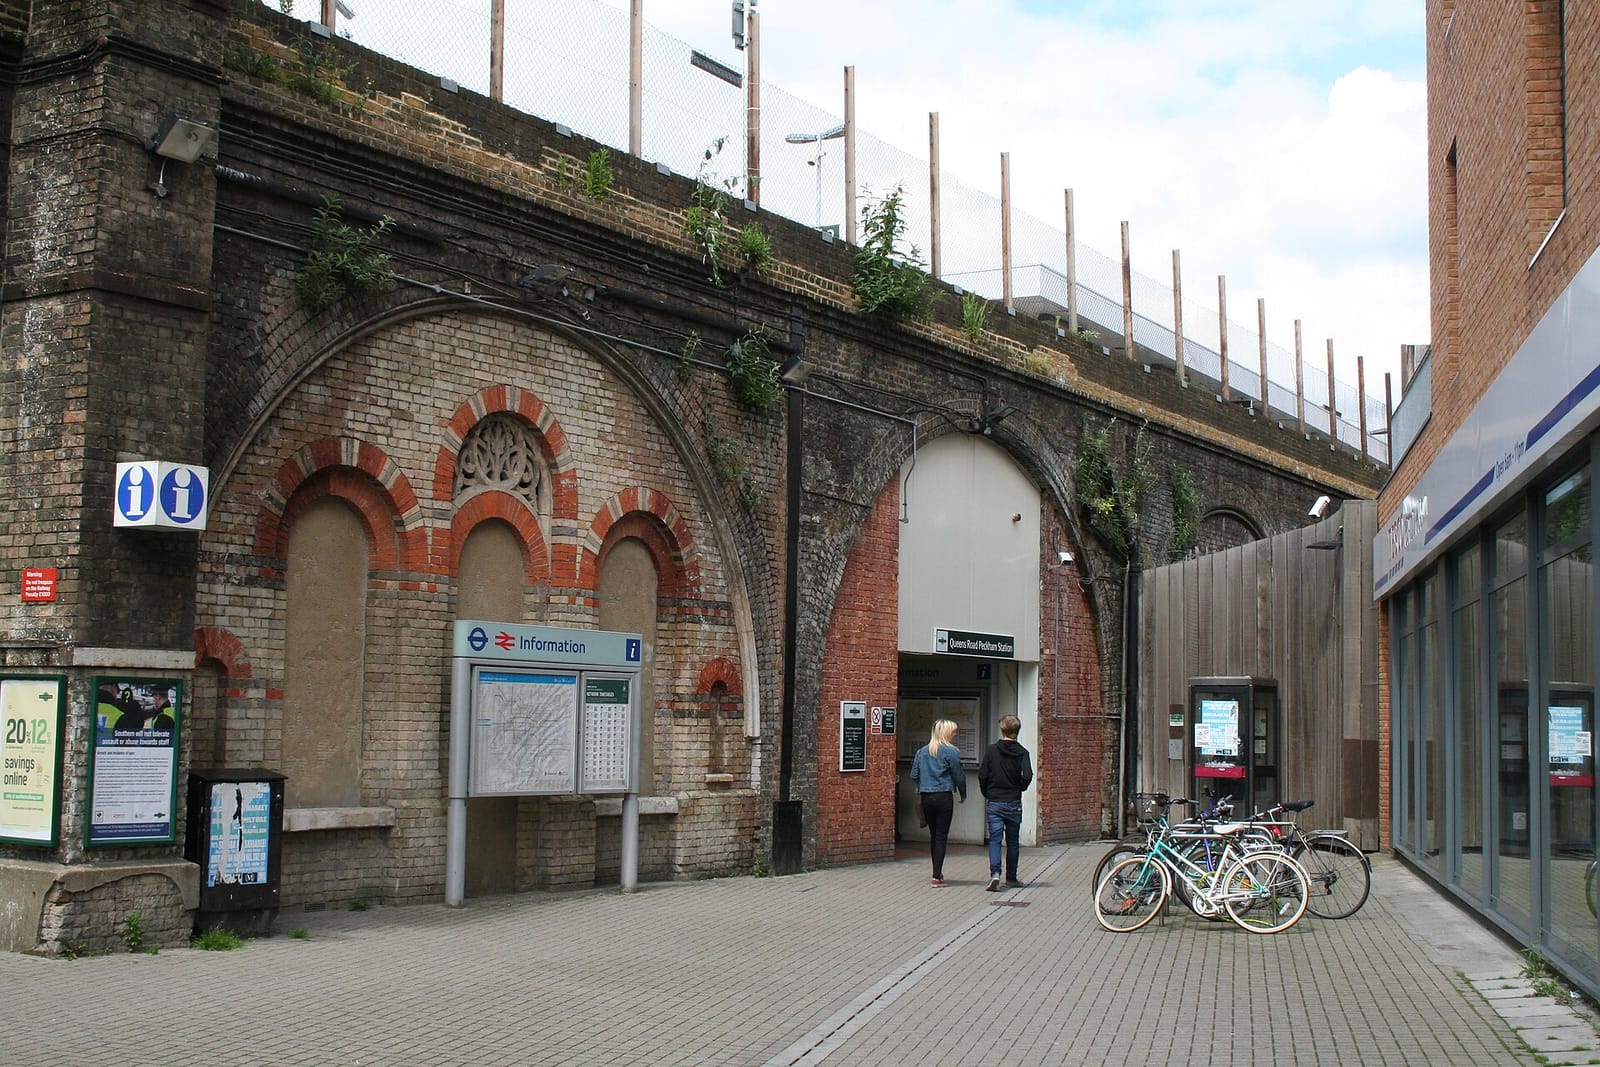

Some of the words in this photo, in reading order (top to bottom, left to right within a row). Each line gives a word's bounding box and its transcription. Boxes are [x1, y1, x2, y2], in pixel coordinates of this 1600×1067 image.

[520, 636, 586, 654] Information
[950, 638, 966, 649] Queens
[967, 640, 978, 650] Road
[979, 640, 998, 652] Peckham
[998, 642, 1012, 652] Station
[4, 756, 34, 773] savings
[4, 772, 28, 786] online
